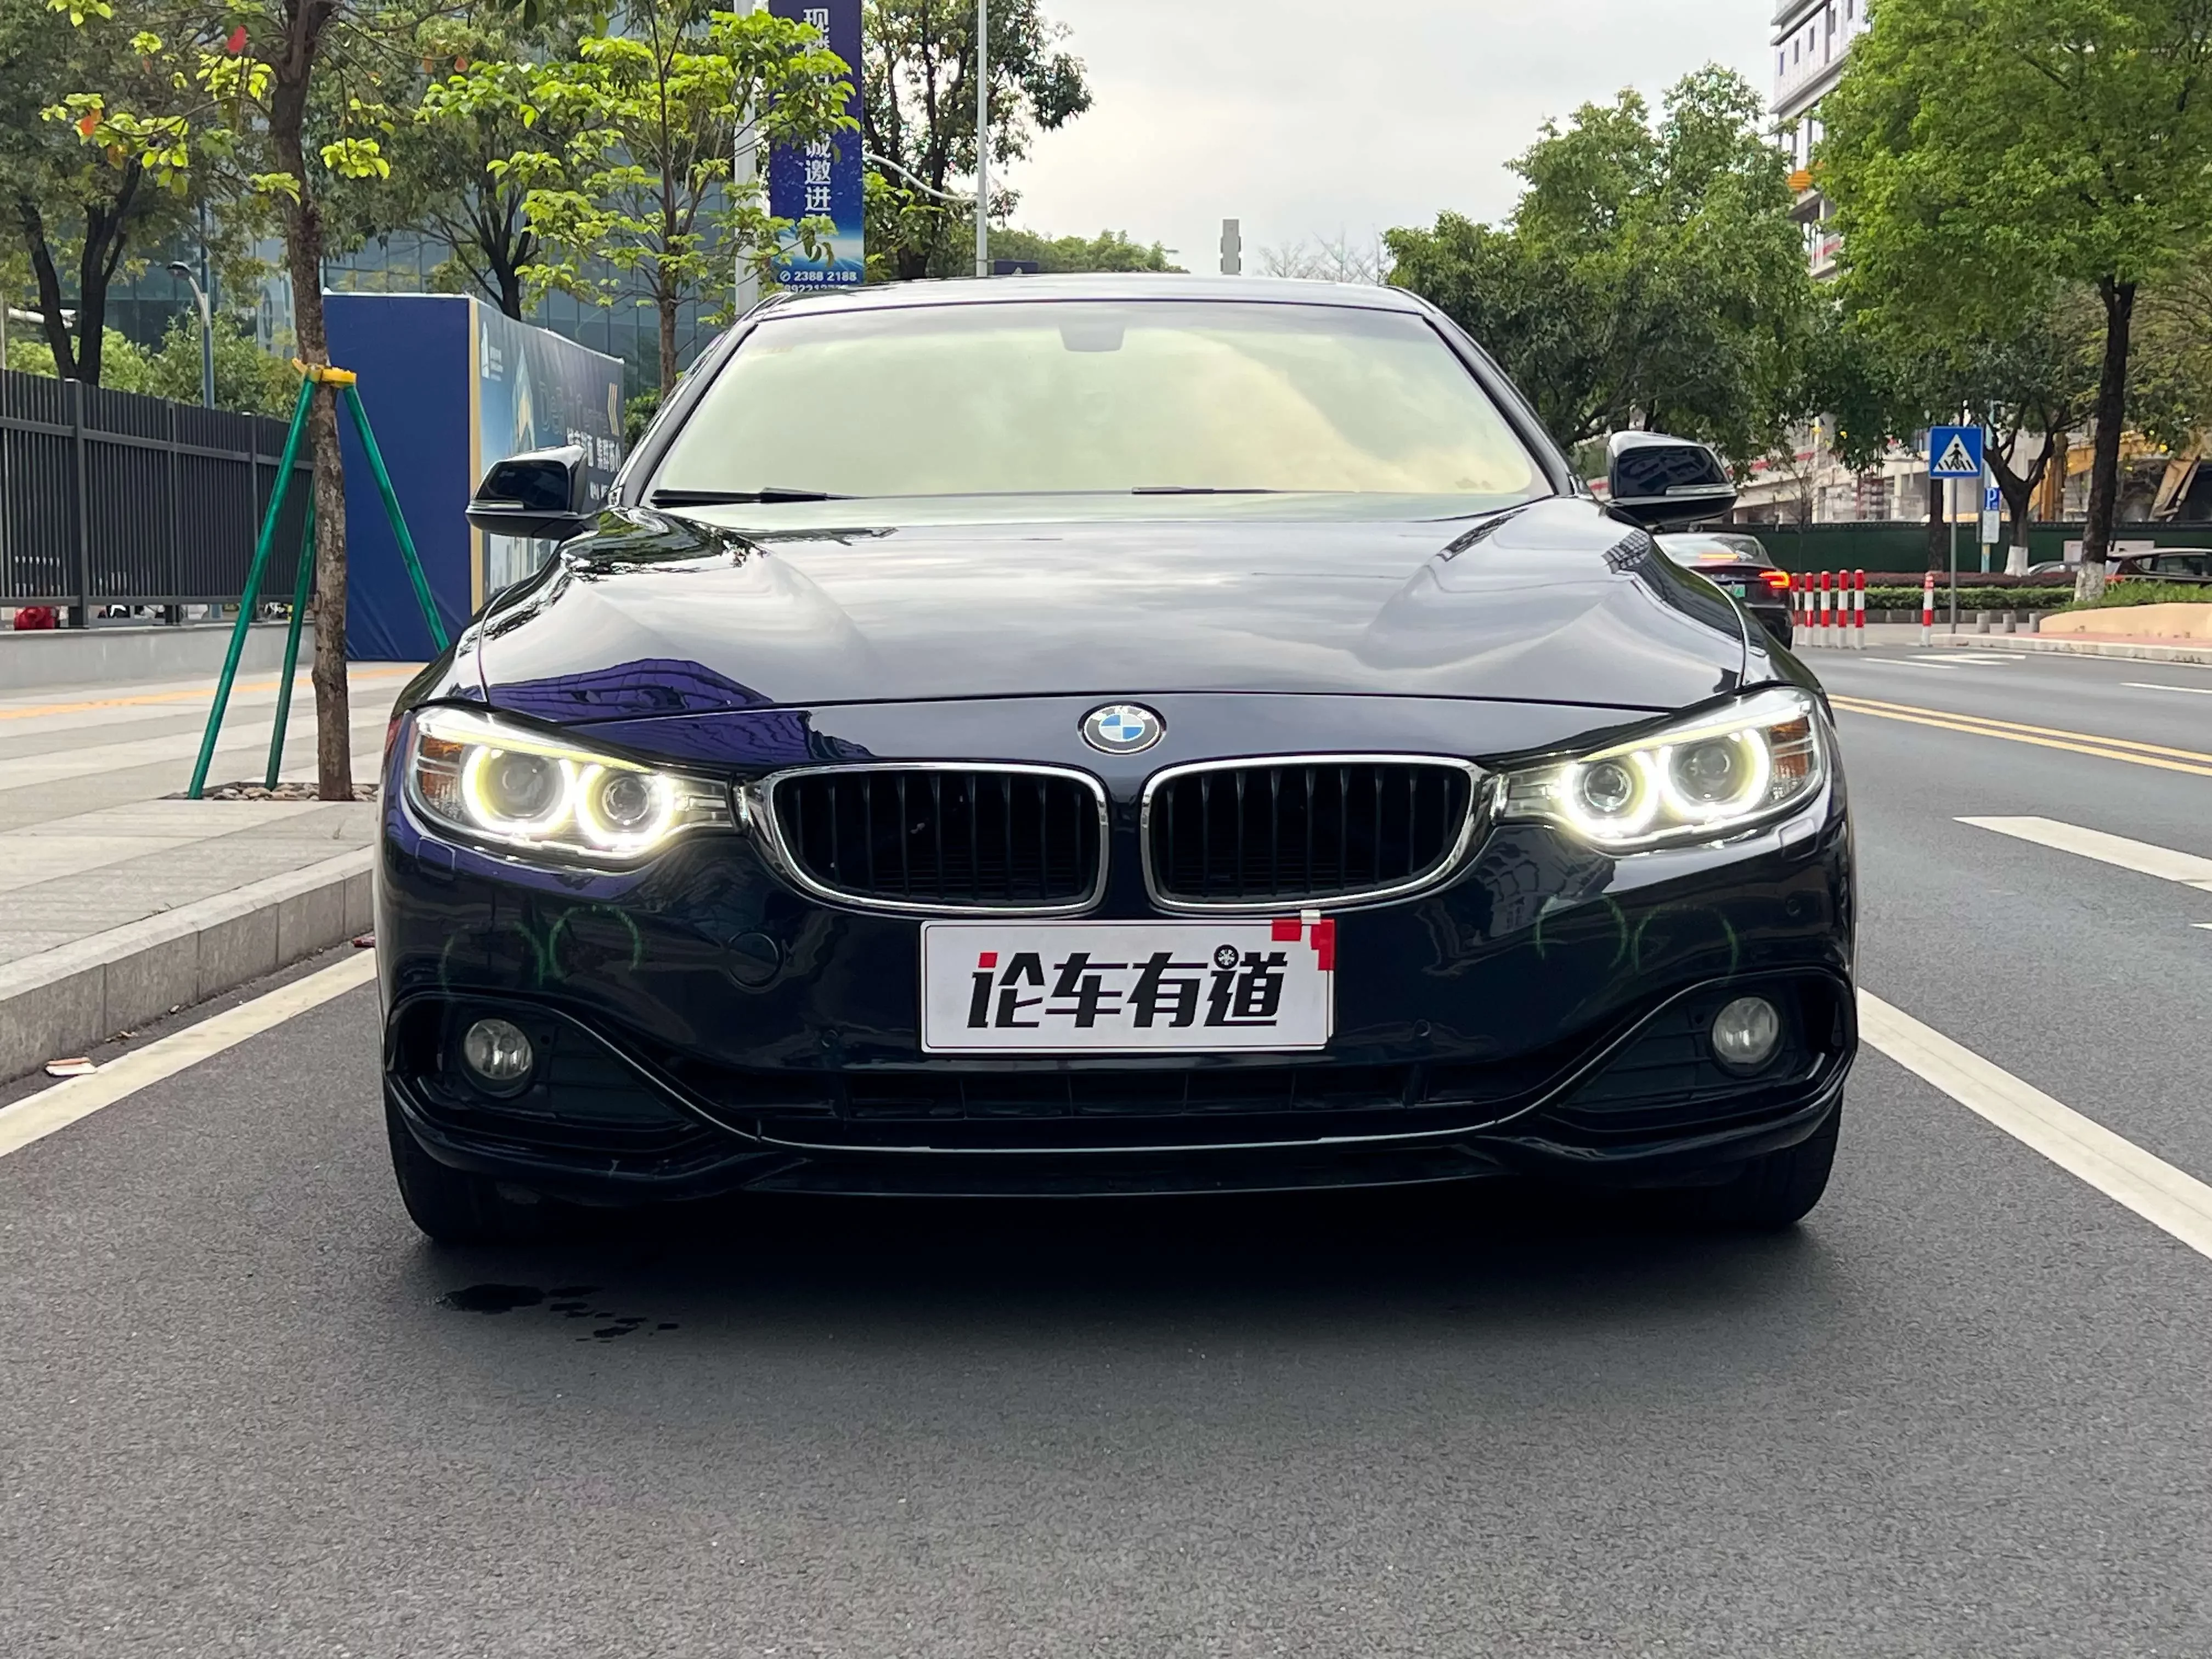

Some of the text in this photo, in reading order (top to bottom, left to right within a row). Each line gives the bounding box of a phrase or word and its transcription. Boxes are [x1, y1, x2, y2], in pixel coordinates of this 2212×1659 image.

[804, 133, 832, 221] 诚邀进
[794, 271, 857, 281] 2388 2188
[1985, 488, 1997, 511] P
[967, 944, 1288, 1029] 论车有道
